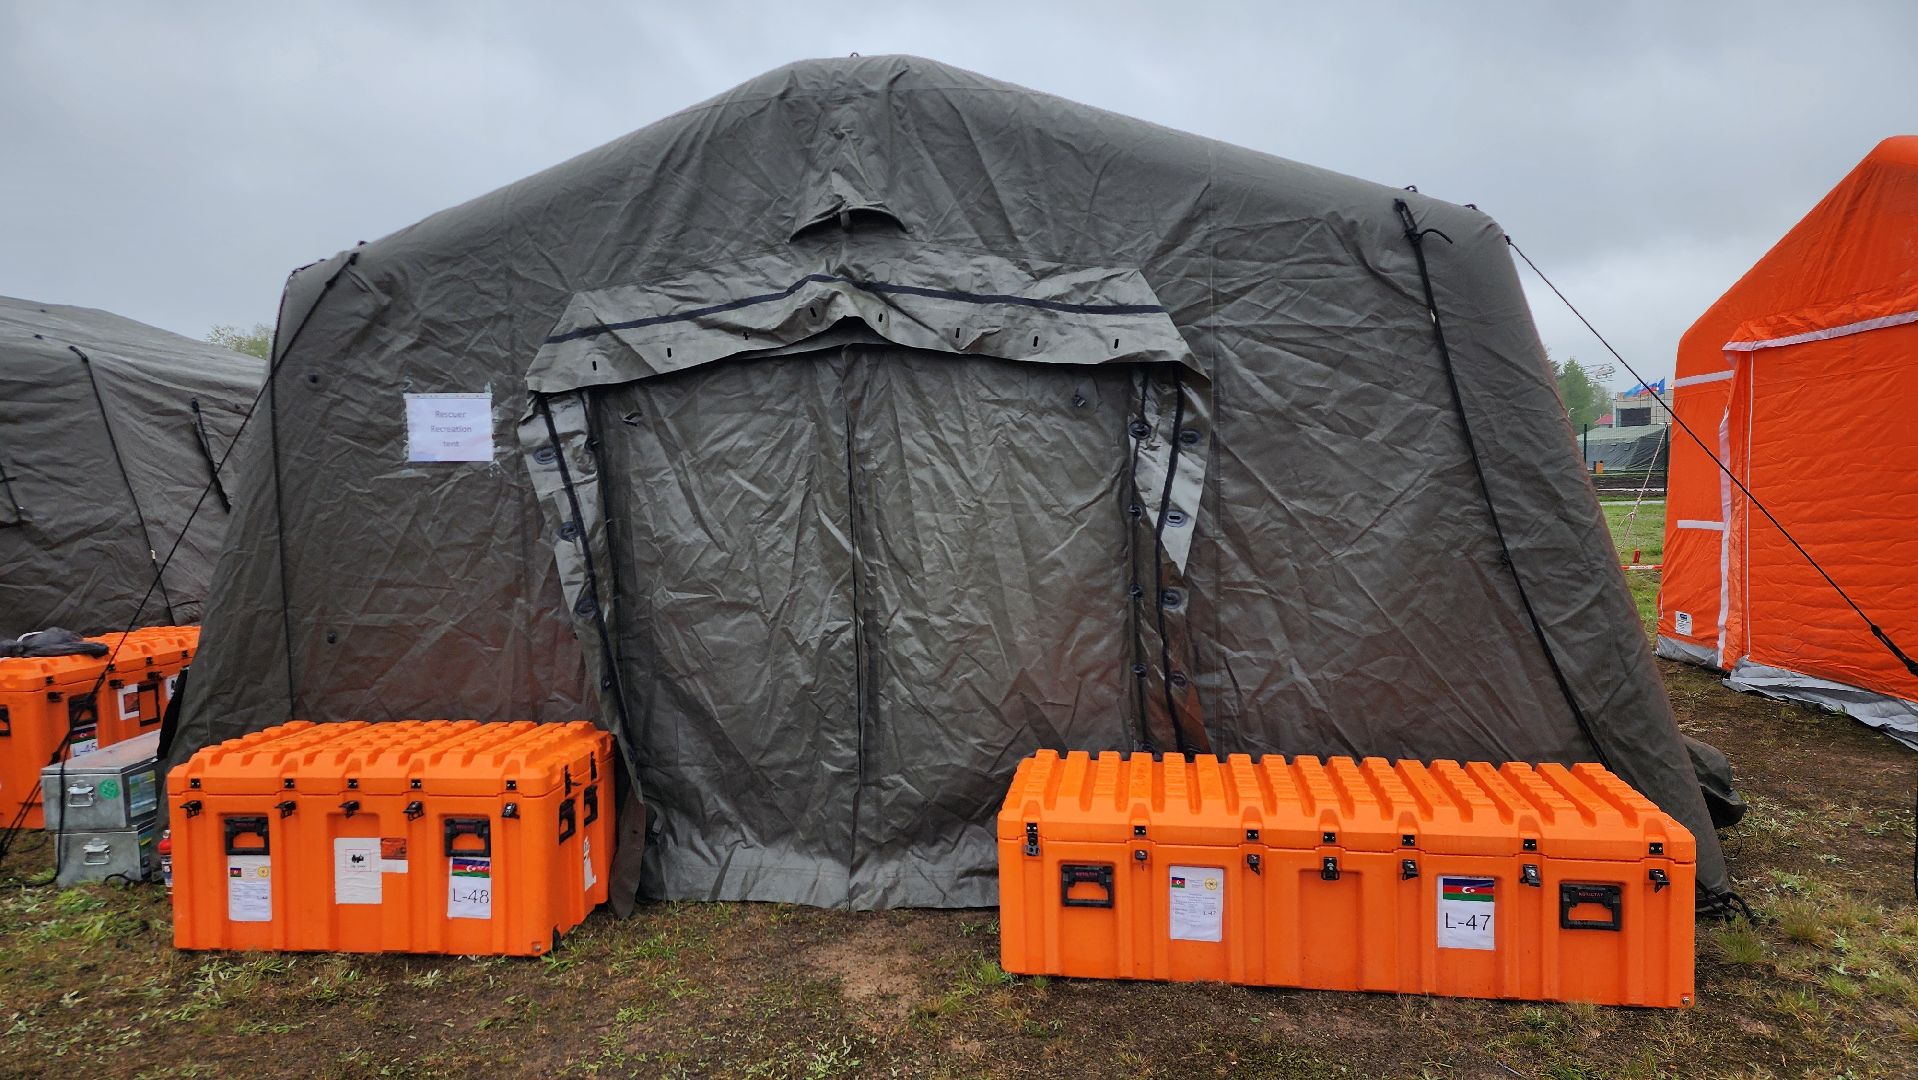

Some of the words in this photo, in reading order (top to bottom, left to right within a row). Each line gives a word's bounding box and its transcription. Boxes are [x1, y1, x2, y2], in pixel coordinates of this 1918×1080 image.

[434, 410, 467, 418] Rescuer
[430, 425, 472, 433] Recreation
[453, 887, 489, 904] L-48
[1445, 911, 1491, 931] L-47
